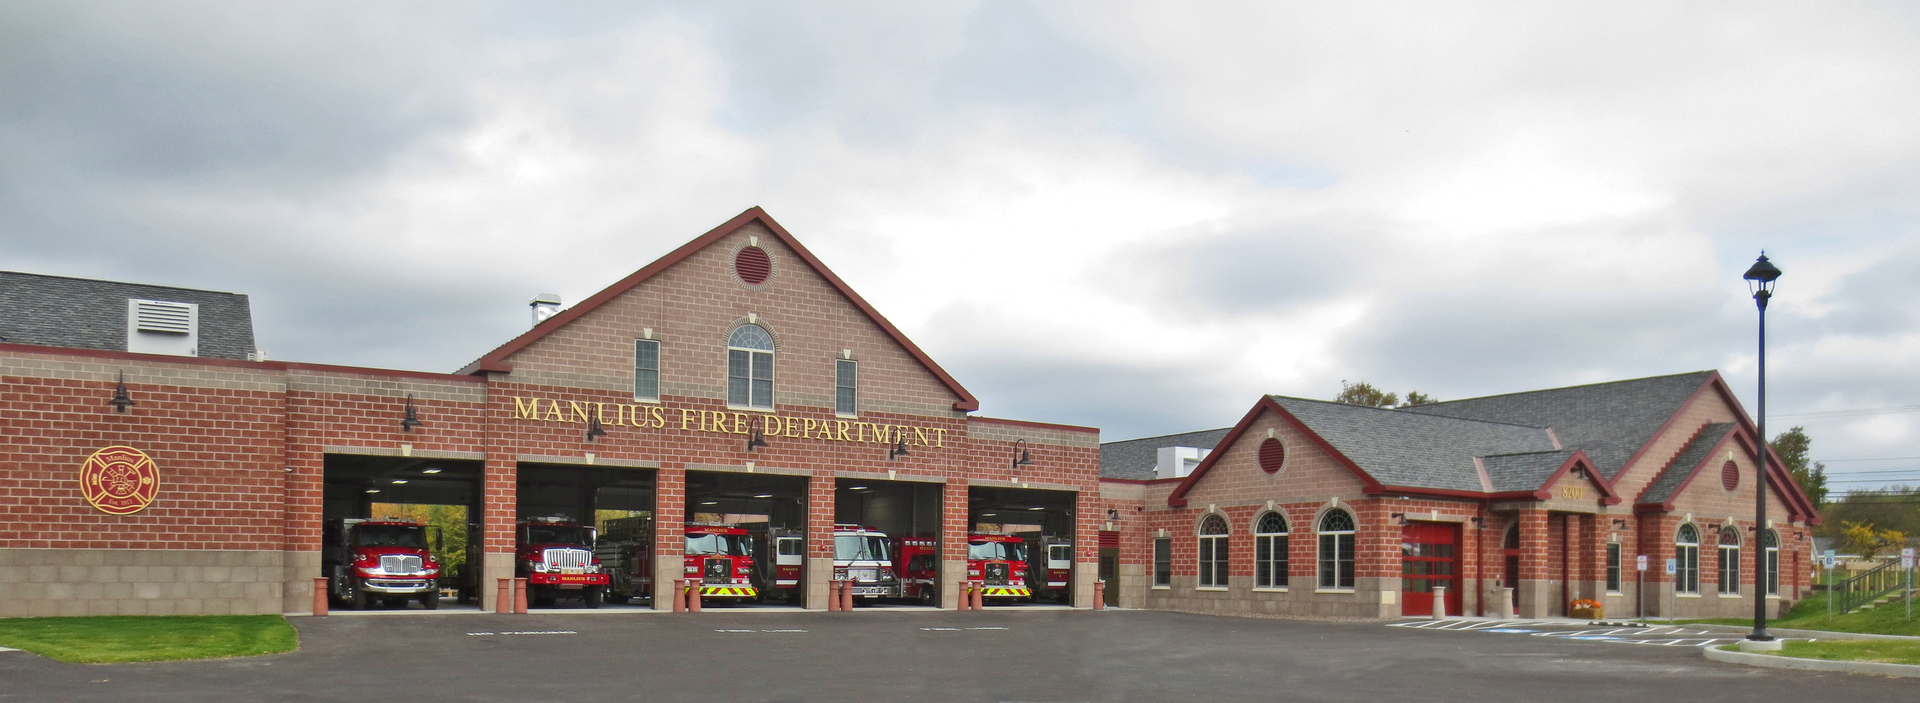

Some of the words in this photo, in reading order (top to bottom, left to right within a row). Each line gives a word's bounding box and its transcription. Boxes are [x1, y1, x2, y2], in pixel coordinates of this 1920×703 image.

[512, 396, 666, 430] MANLIUS
[680, 408, 749, 435] FIRE
[762, 414, 948, 449] DEPARTMENT
[105, 454, 135, 463] Manlius
[1562, 486, 1583, 499] 8200
